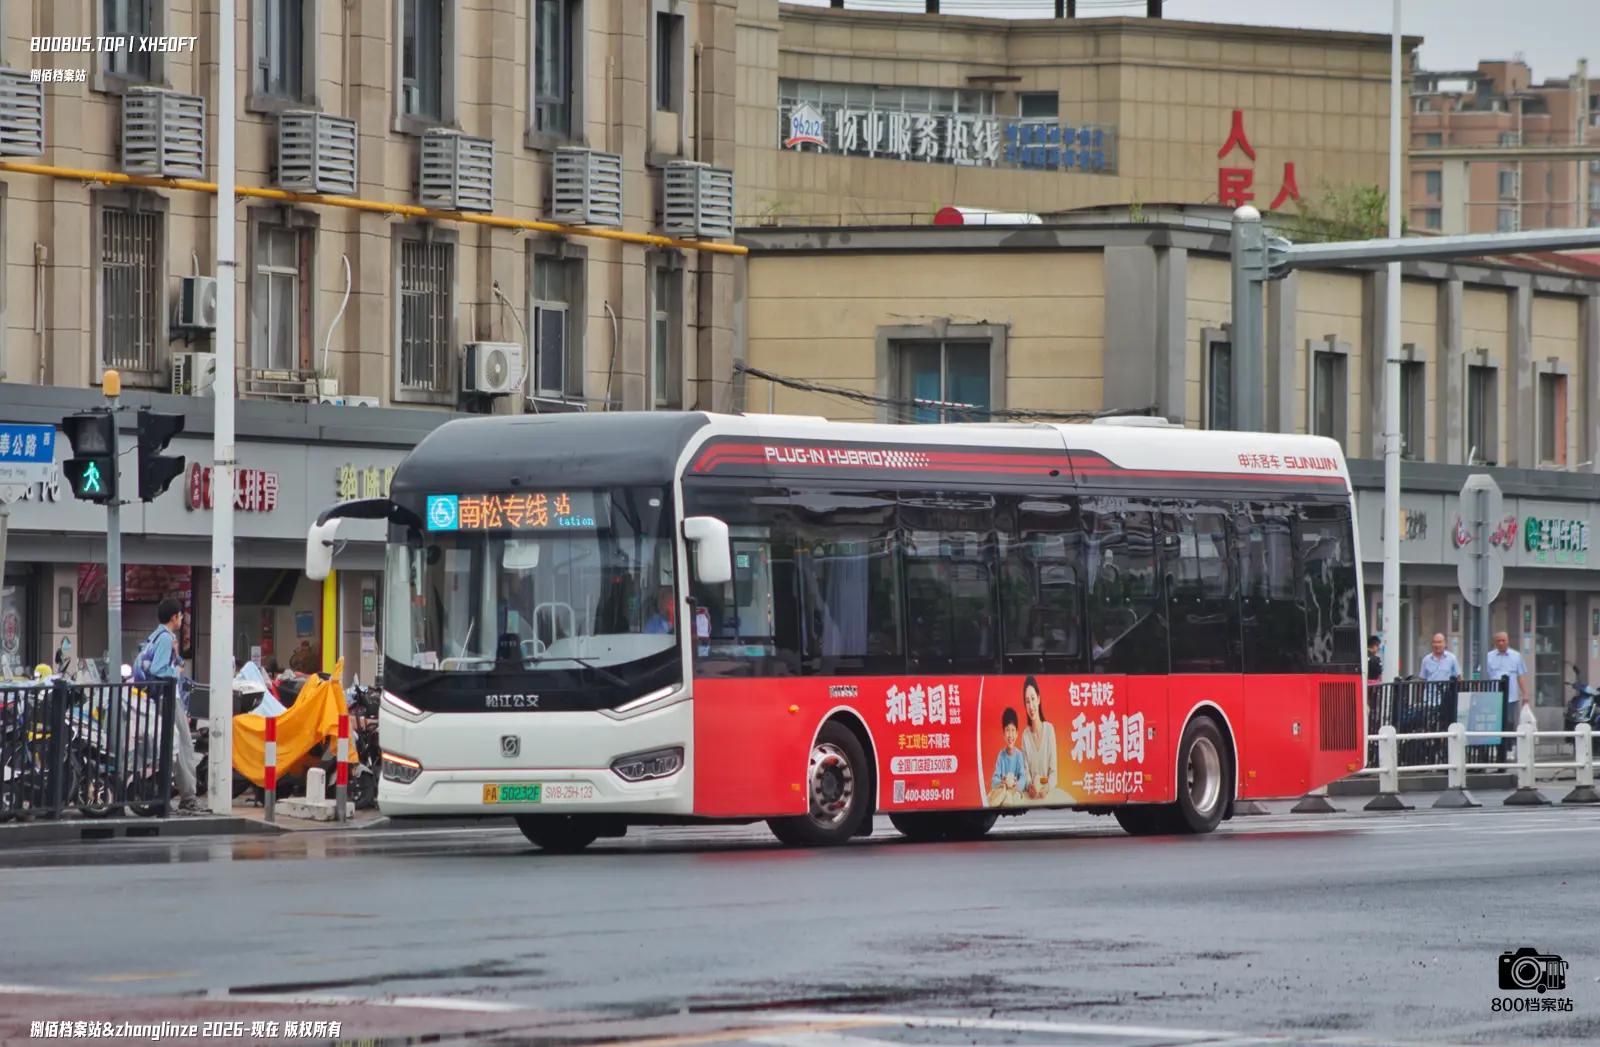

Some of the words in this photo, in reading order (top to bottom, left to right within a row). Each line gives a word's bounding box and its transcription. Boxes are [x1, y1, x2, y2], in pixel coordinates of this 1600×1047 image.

[835, 109, 999, 160] 物业服务热线
[828, 449, 883, 466] HYBRID
[1238, 453, 1281, 469] 申沃客车
[1284, 456, 1338, 470] SUNWIN
[459, 494, 549, 529] 南松专线
[485, 694, 539, 707] 松江公交
[1069, 682, 1115, 706] 包子就吃
[886, 683, 946, 726] 和善园
[1071, 711, 1145, 765] 和善园
[897, 758, 953, 772] 全国门店超1500家
[545, 786, 593, 799] SWB-25H-123
[1072, 771, 1144, 794] 一年卖出6亿只
[904, 788, 955, 801] 400-8899-181
